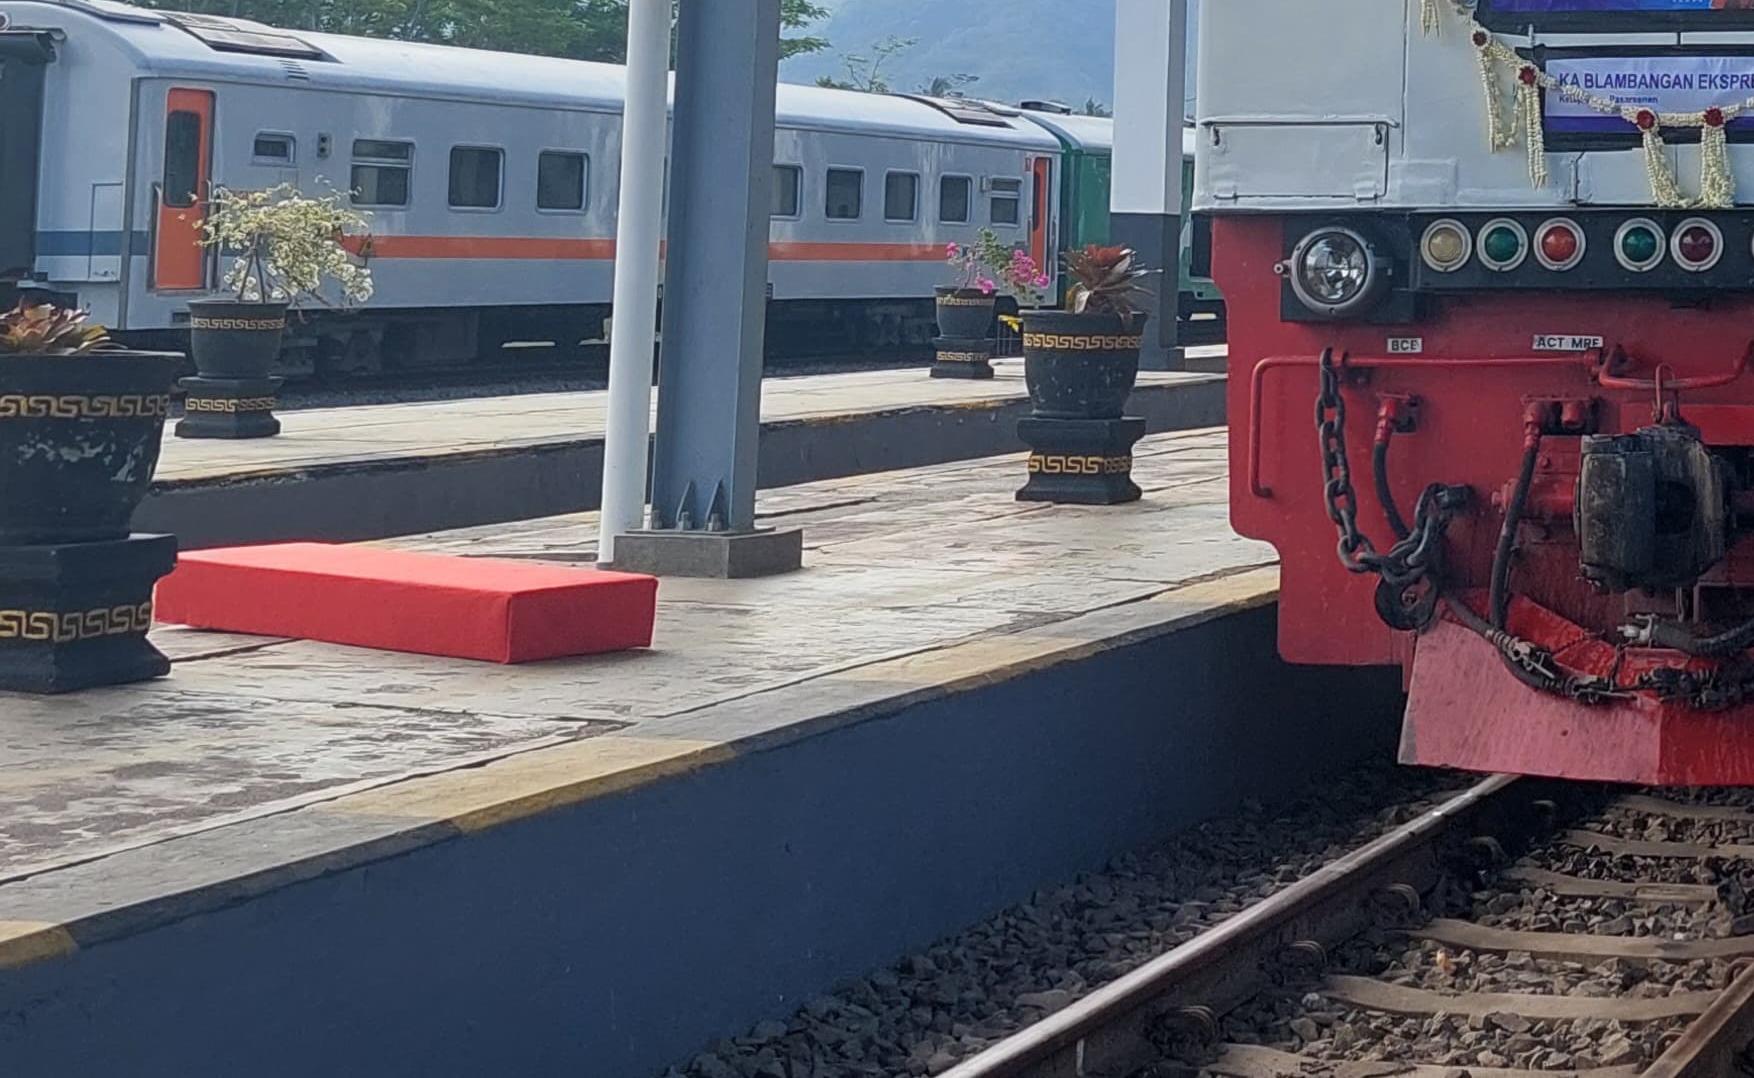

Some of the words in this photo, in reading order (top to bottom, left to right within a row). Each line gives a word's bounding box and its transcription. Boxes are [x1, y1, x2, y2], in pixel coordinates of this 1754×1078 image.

[1559, 73, 1581, 89] KA
[1584, 73, 1693, 89] BLAMBANGAN
[1391, 339, 1417, 351] BCE
[1537, 337, 1565, 348] ACT
